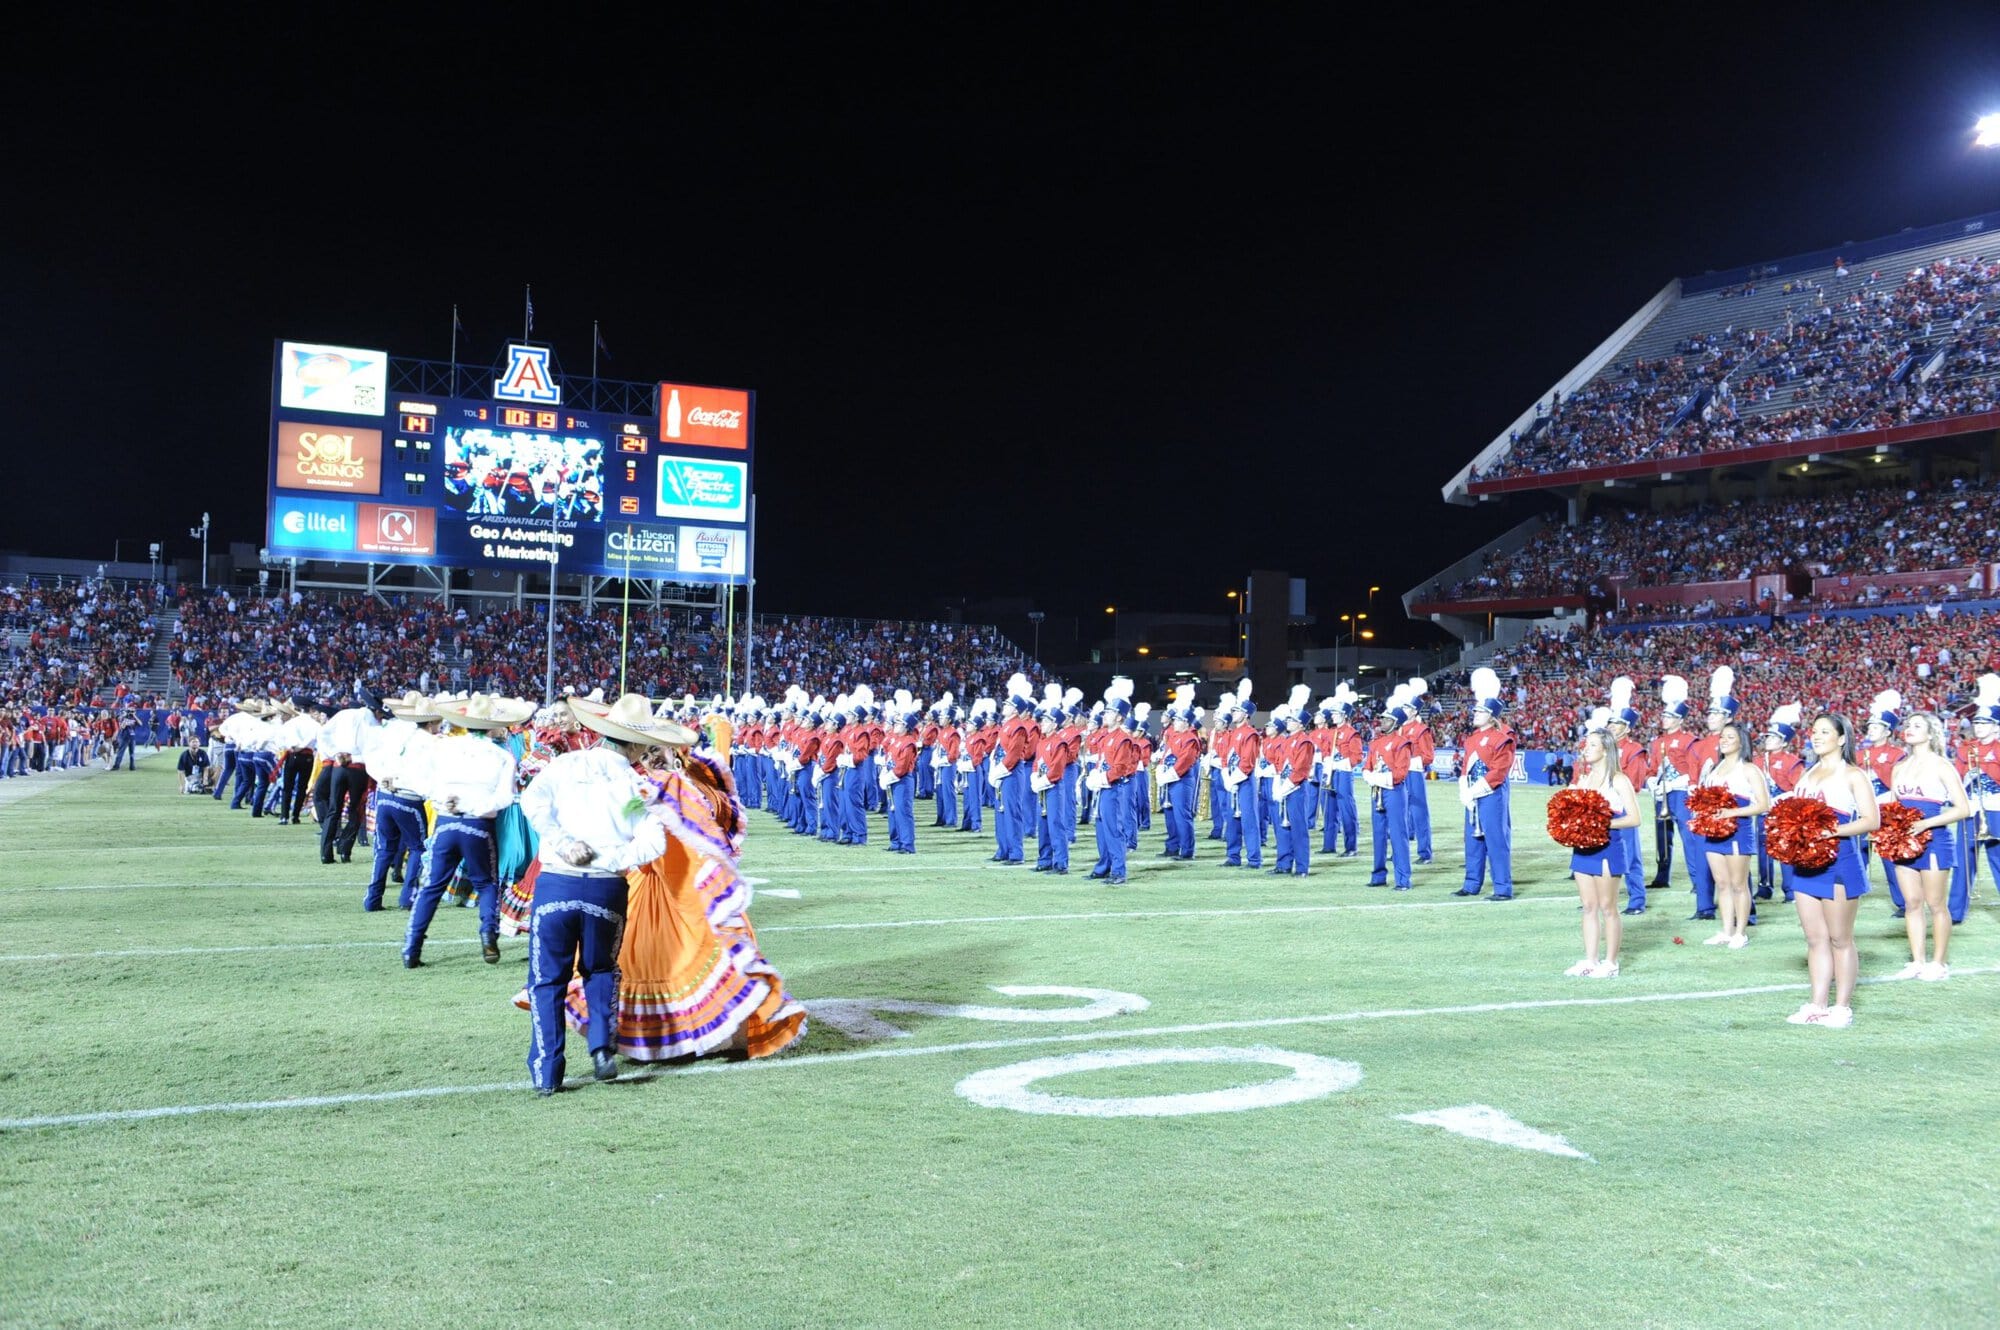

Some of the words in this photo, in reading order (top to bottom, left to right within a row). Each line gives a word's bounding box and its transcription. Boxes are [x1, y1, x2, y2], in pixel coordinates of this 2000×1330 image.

[494, 345, 561, 404] A
[463, 409, 478, 418] TOL
[479, 408, 487, 420] 3
[505, 408, 556, 430] 10:19
[566, 417, 574, 429] 3
[575, 420, 589, 429] TOL
[407, 415, 427, 432] 14
[297, 431, 364, 466] SOL
[622, 436, 646, 452] 24
[296, 461, 365, 479] CASINOS
[626, 468, 636, 481] 3
[501, 527, 574, 547] Advertising
[608, 531, 676, 553] Citizen
[641, 529, 675, 541] Tucson
[483, 544, 495, 557] &
[496, 545, 559, 564] Marketing
